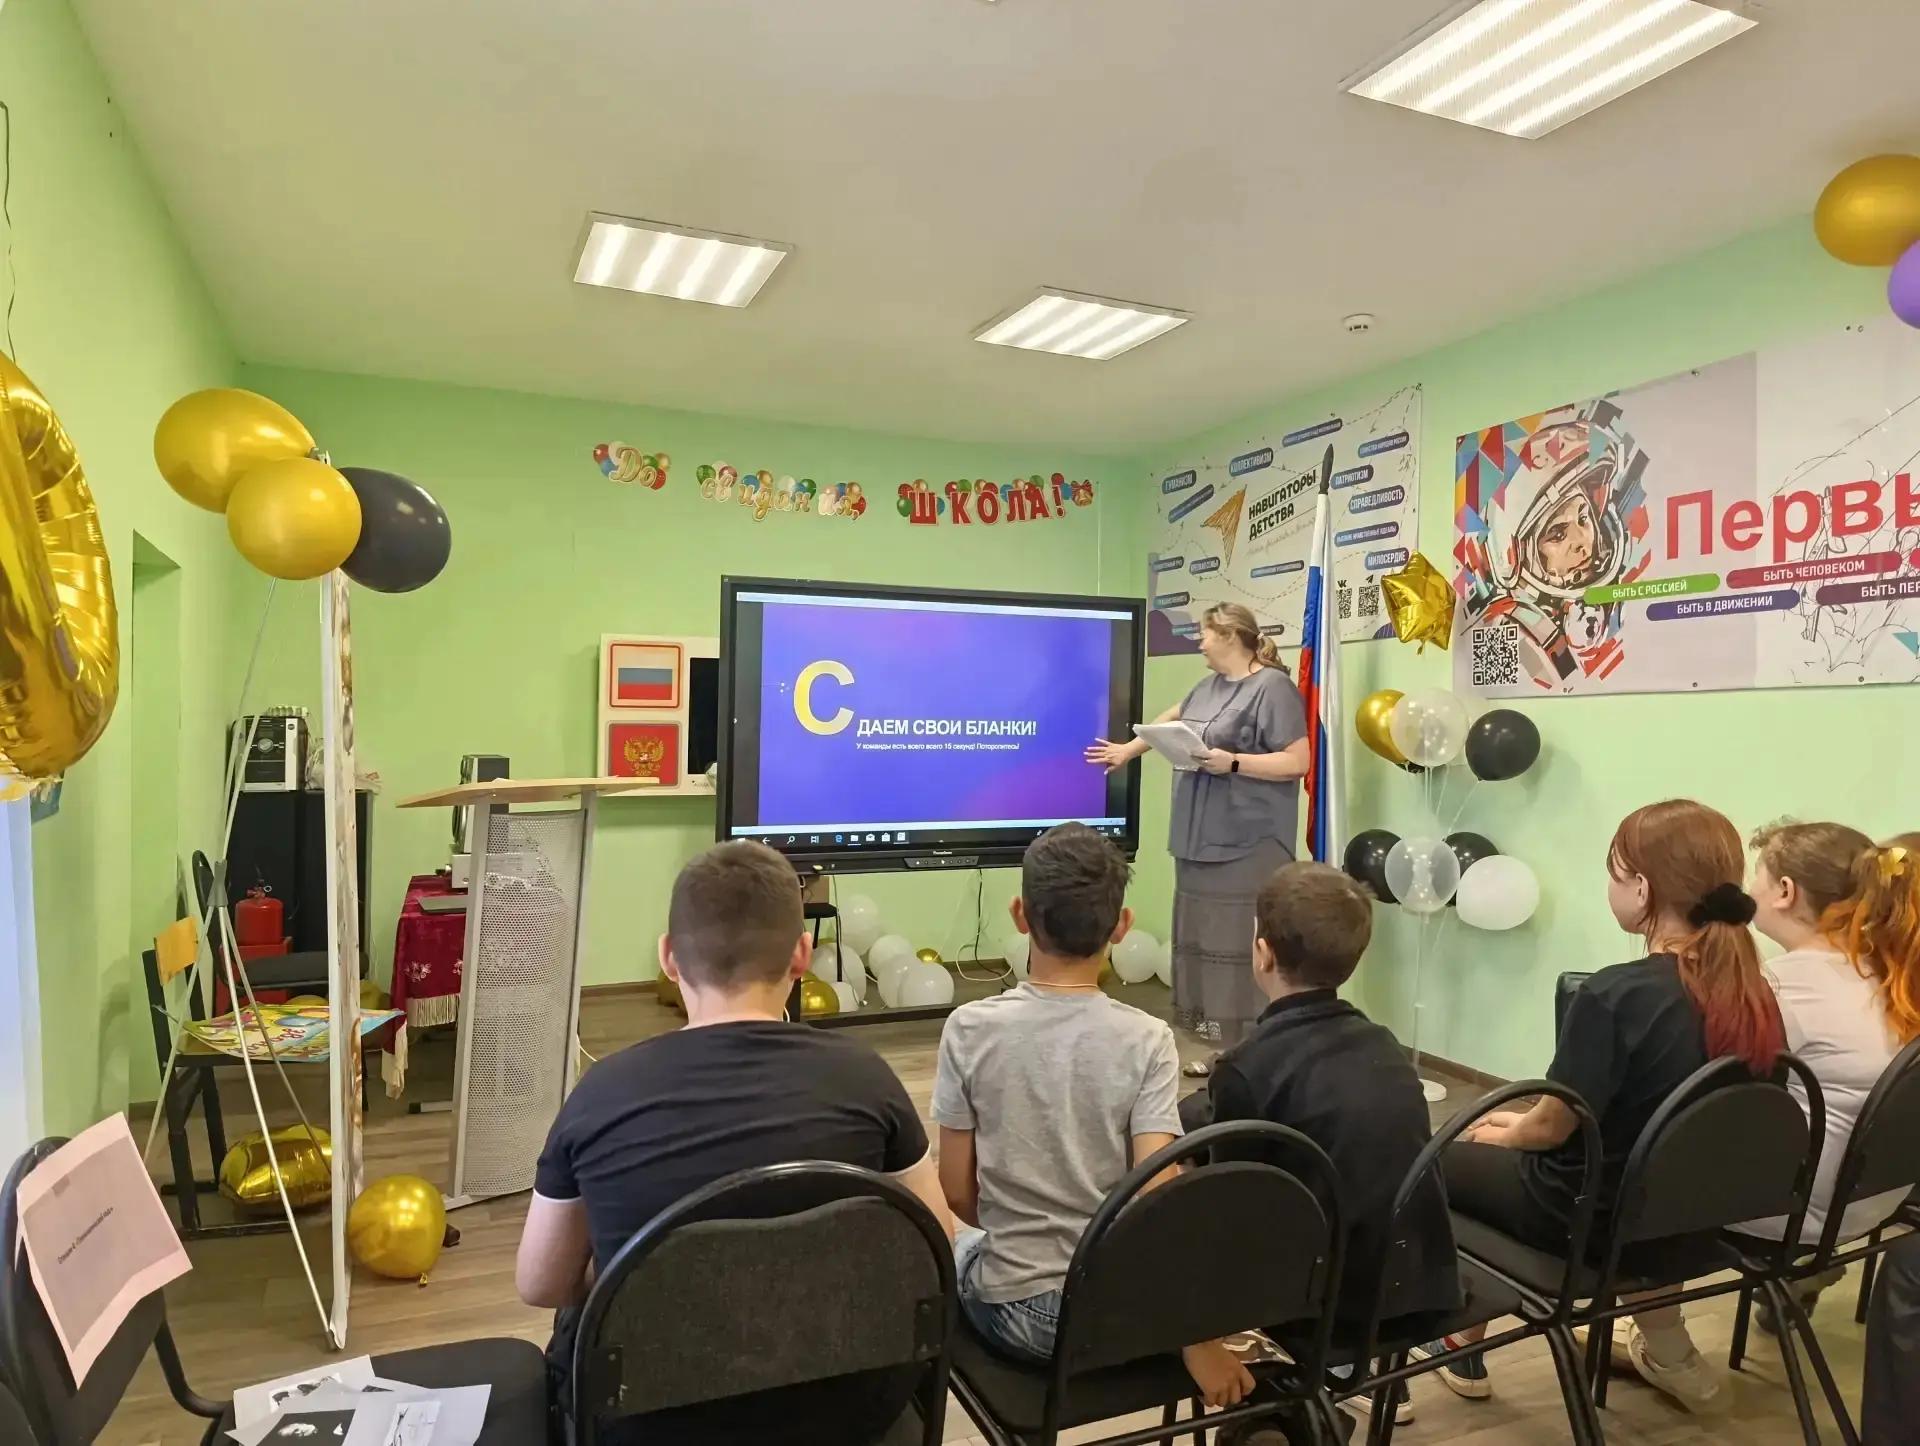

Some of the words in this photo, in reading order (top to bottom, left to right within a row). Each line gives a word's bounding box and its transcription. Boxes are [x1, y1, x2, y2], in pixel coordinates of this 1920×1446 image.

[1231, 452, 1272, 473] КОЛЛЕКТИВИЗМ
[608, 446, 657, 488] До
[908, 484, 1066, 526] ШКОЛА!
[1165, 473, 1193, 491] ГУМАНИЗМ
[1335, 469, 1369, 486] ПАТРИОТИЗМ
[1249, 469, 1316, 521] НАВИГАТОРЫ
[1350, 489, 1403, 510] СПРАВЕДЛИВОСТЬ
[1249, 503, 1295, 541] ДЕТСТВА
[1368, 551, 1406, 567] МИЛОСЕРДИЕ
[1763, 569, 1794, 582] БЫТЬ
[1796, 560, 1865, 577] ЧЕЛОВЕКОМ
[1612, 588, 1637, 599] БЫТЬ
[1638, 586, 1644, 596] С
[1645, 580, 1687, 595] РОССИЕЙ
[1861, 584, 1896, 598] БЫТЬ
[1677, 603, 1704, 615] БЫТЬ
[1705, 601, 1712, 612] В
[1713, 596, 1773, 612] ДВИЖЕНИИ
[912, 720, 961, 735] СВОИ
[965, 720, 1037, 736] БЛАНКИ!
[856, 742, 862, 750] У
[862, 743, 892, 751] команды
[953, 743, 976, 751] секунд!
[976, 742, 1020, 751] Поторопитесь!
